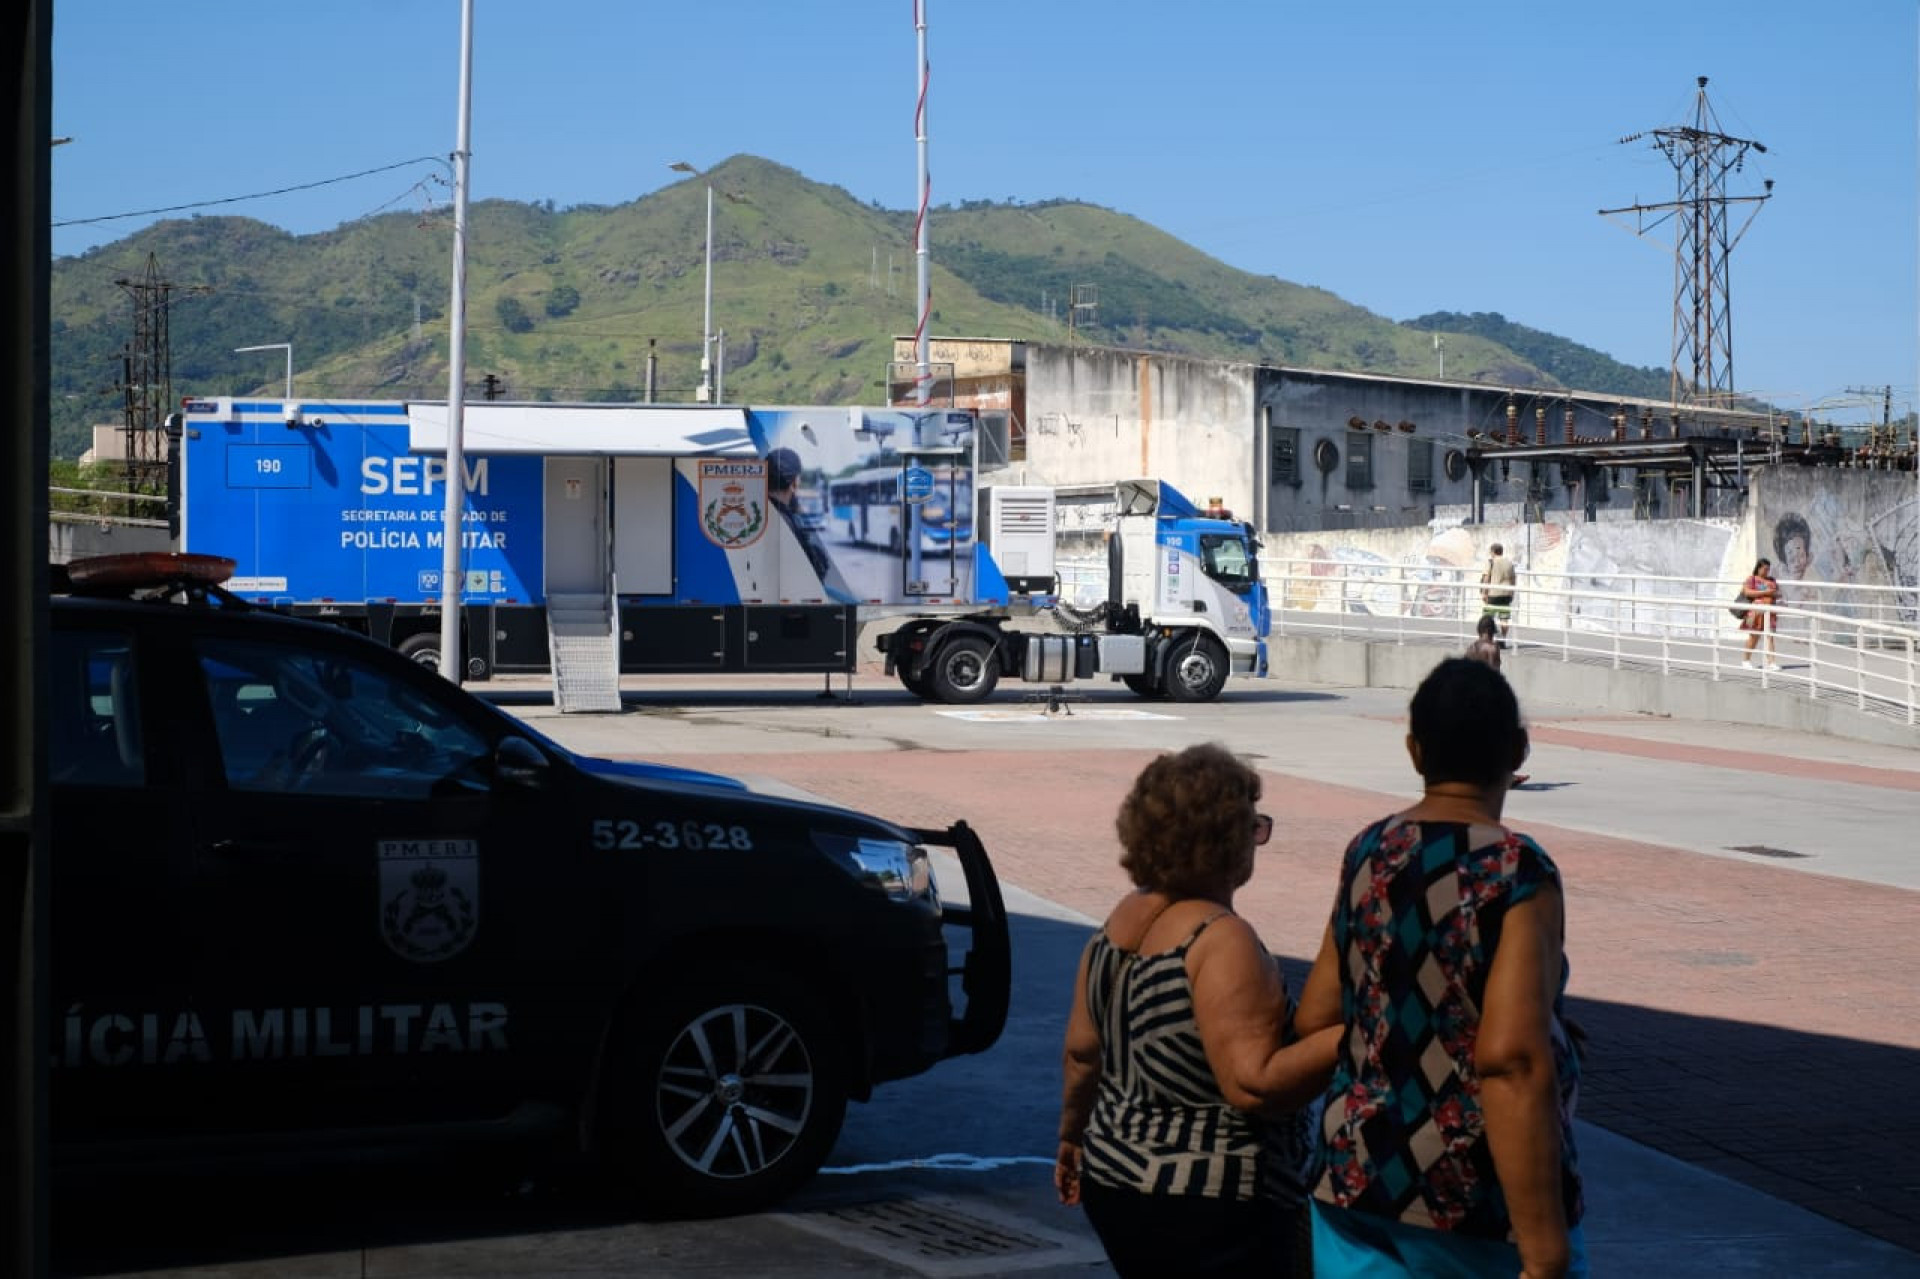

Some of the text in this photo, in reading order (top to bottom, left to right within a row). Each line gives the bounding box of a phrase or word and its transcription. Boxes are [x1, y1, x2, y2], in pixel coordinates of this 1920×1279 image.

[256, 458, 281, 473] 190
[361, 456, 488, 496] SEPM
[704, 464, 763, 475] PMERJ
[342, 510, 417, 521] SECRETARIA
[420, 510, 437, 521] DE
[491, 511, 507, 522] DE
[341, 527, 506, 549] POLÍCIA MITAR
[594, 819, 753, 850] 52-3628
[51, 999, 510, 1068] ÍCIA MILITAR
